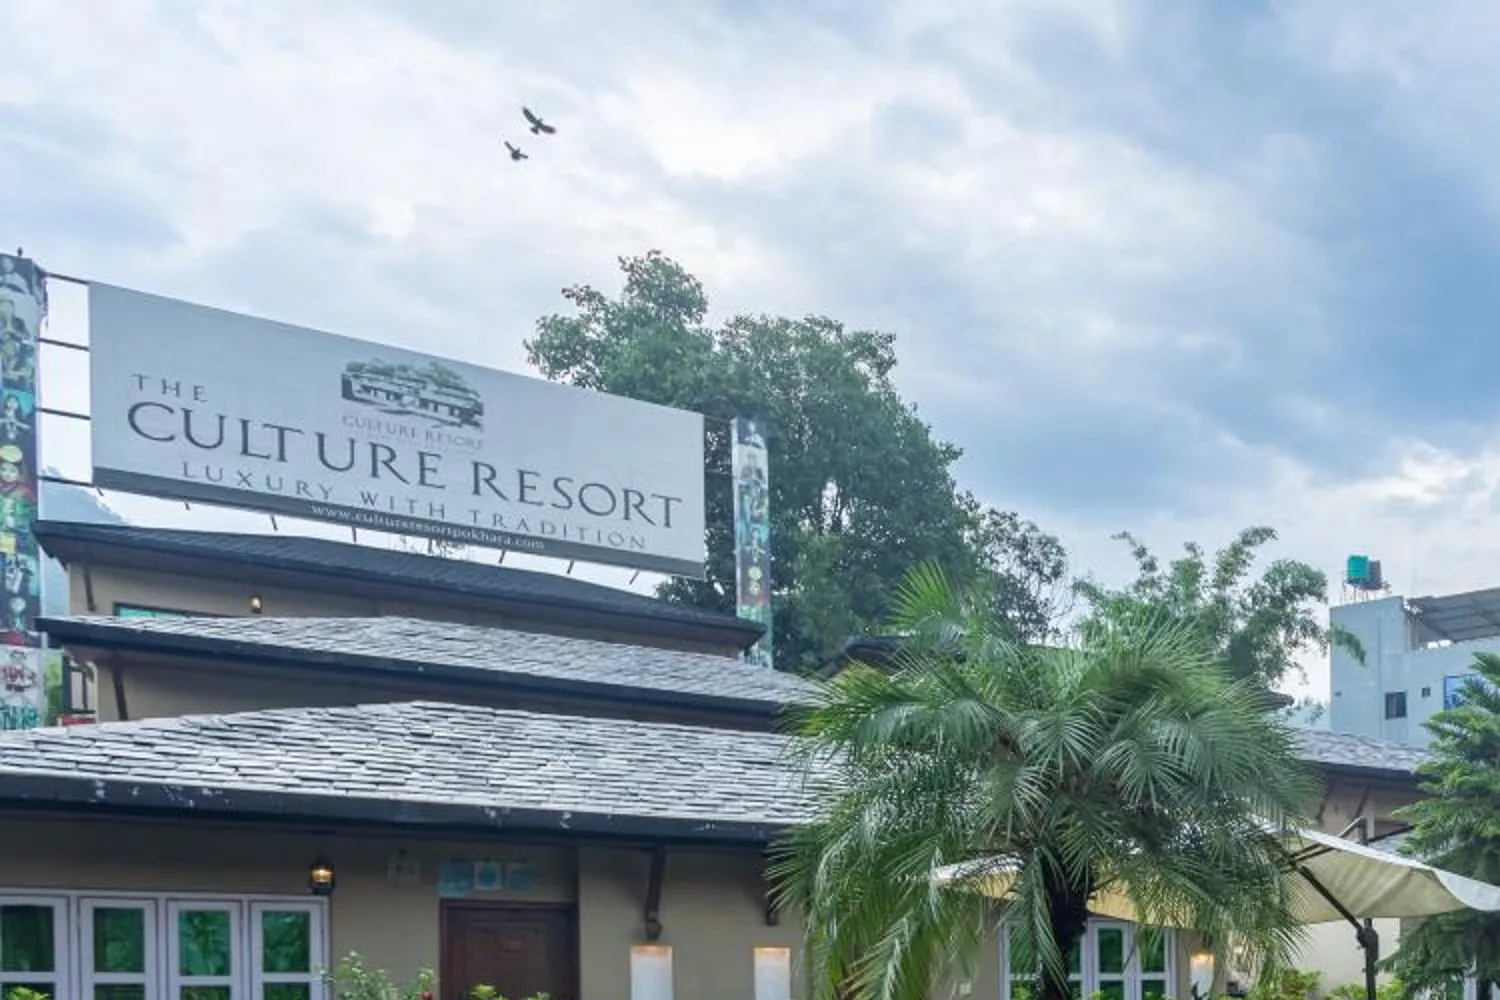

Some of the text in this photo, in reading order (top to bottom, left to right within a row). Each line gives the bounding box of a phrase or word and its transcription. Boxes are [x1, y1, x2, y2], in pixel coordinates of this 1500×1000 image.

[132, 373, 208, 402] THE
[127, 401, 683, 529] CULTURE RESORT
[182, 461, 646, 549] LUXURY WITH TRADITION
